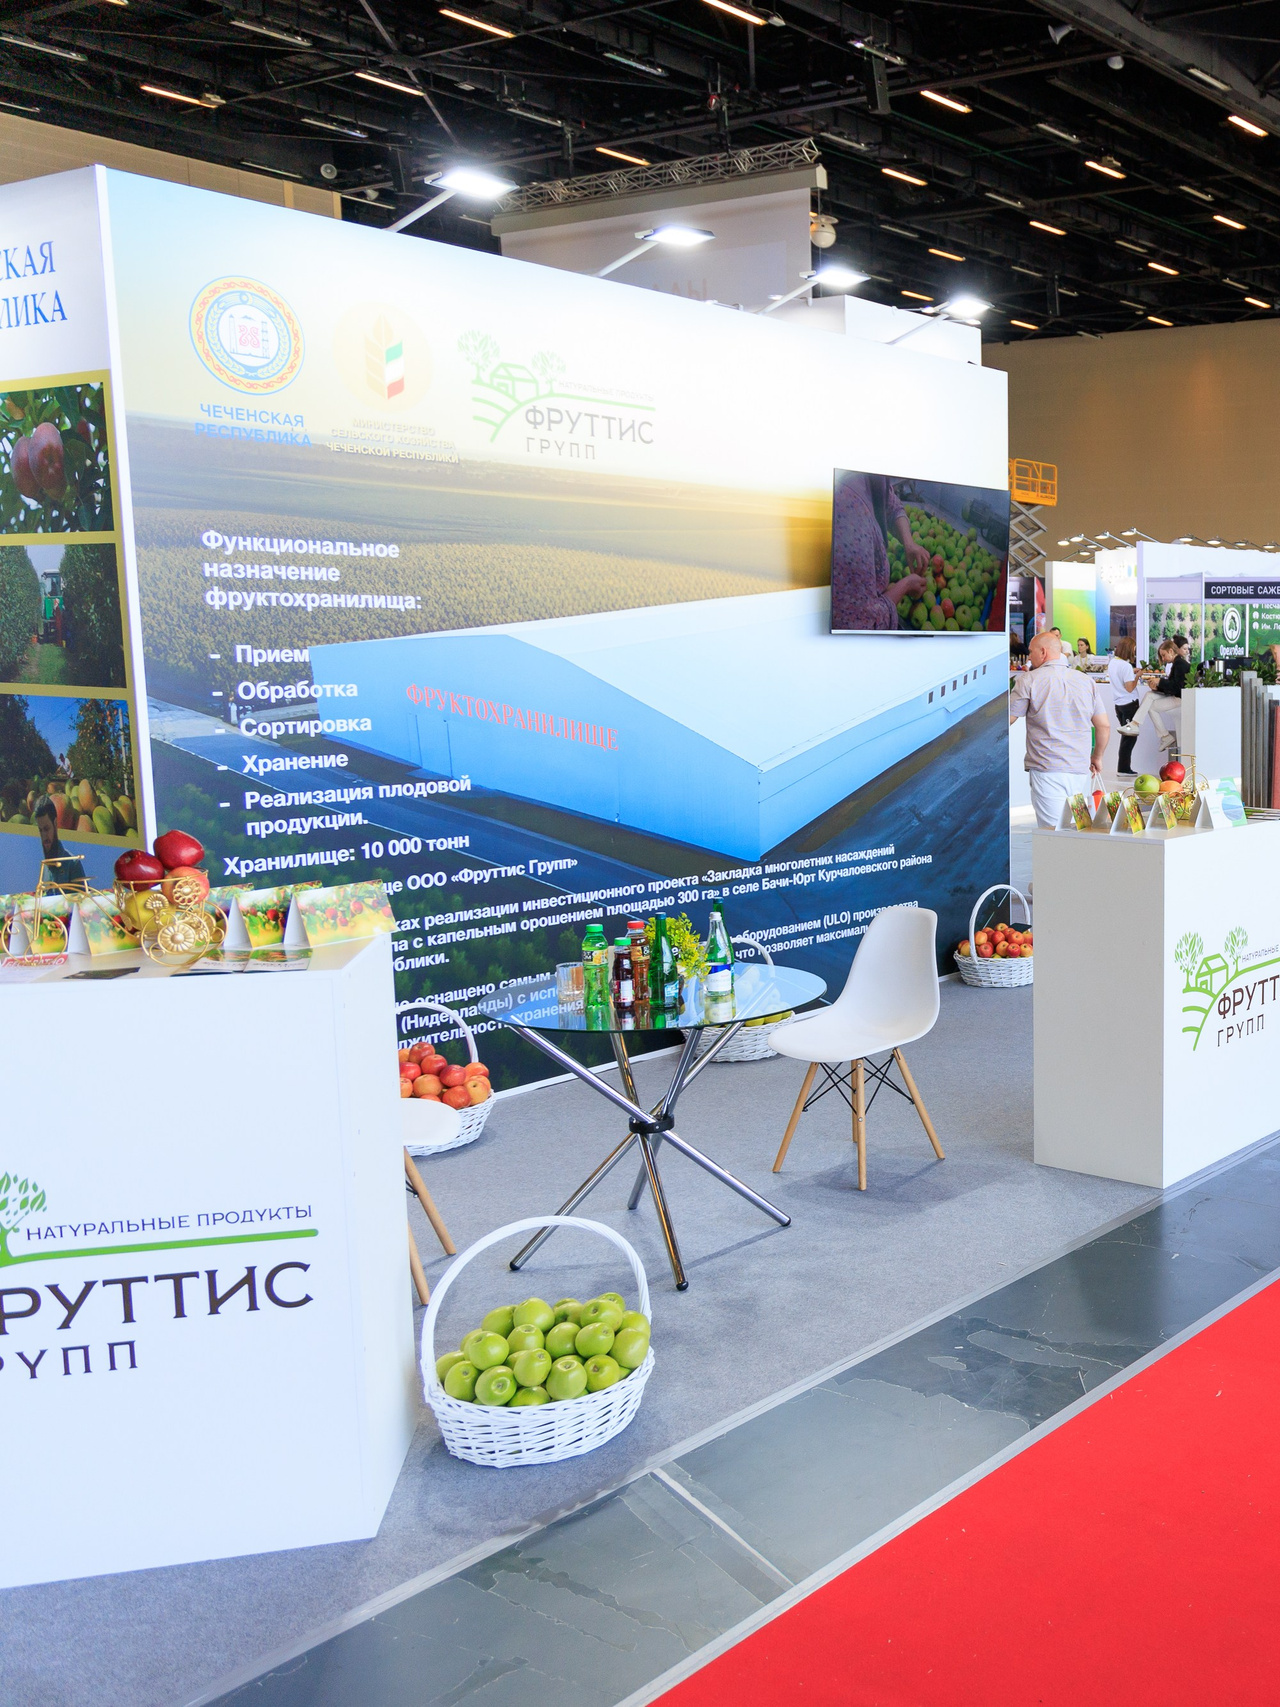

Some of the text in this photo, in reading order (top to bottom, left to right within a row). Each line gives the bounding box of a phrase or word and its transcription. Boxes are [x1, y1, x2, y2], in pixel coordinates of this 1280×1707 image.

[0, 241, 56, 280] КАЯ
[200, 403, 304, 428] ЧЕЧЕНСКАЯ
[352, 418, 435, 436] МИНИСТЕРСТВО
[525, 405, 655, 445] ФРУТТИС
[194, 422, 312, 448] РЕСПУБЛИКА
[330, 427, 394, 443] СЕЛЬСКОГО
[325, 441, 460, 464] ЧЕЧЕНСКОЙ РЕСПУБЛИКИ
[526, 437, 596, 460] ГРУПП
[202, 530, 400, 558] Функциональное
[204, 562, 341, 582] назначение
[205, 586, 422, 611] фруктохранилища:
[1210, 585, 1254, 595] СОРТОВЫЕ
[235, 645, 310, 666] Прием
[238, 680, 358, 702] Обработка
[240, 715, 372, 740] Сортировка
[406, 683, 619, 752] ФРУКТОХРАНИЛИЩЕ
[242, 752, 348, 776] Хранение
[245, 775, 471, 810] Реализация плодовой
[246, 810, 368, 839] продукции.
[224, 833, 470, 877] Хранилище: 10 000 тонн
[407, 871, 448, 890] ООО
[451, 862, 525, 885] «Фруттис
[529, 857, 578, 875] Групп»
[424, 902, 519, 930] реализации
[522, 884, 645, 912] инвестиционного
[648, 874, 699, 895] проекта
[702, 863, 762, 884] «Закладка
[765, 855, 834, 875] многолетних
[835, 844, 895, 864] насаждений
[413, 937, 423, 949] с
[427, 921, 517, 947] капельным
[521, 907, 603, 931] орошением
[606, 893, 675, 918] площадью
[678, 887, 699, 904] 300
[702, 885, 721, 901] га»
[722, 886, 730, 897] в
[732, 881, 760, 895] селе
[762, 872, 816, 892] Бачи-Юрт
[818, 860, 898, 884] Курчалоевского
[900, 853, 933, 870] района
[393, 952, 449, 971] блики.
[417, 982, 496, 1005] оснащено
[823, 910, 851, 929] (ULO)
[735, 947, 755, 960] что
[1241, 944, 1279, 963] НАТУРАЛЬНЫЕ
[1217, 1014, 1265, 1047] ГРУПП
[26, 1204, 312, 1241] НАТУРАЛЬНЫЕ ПРОДУКТЫ
